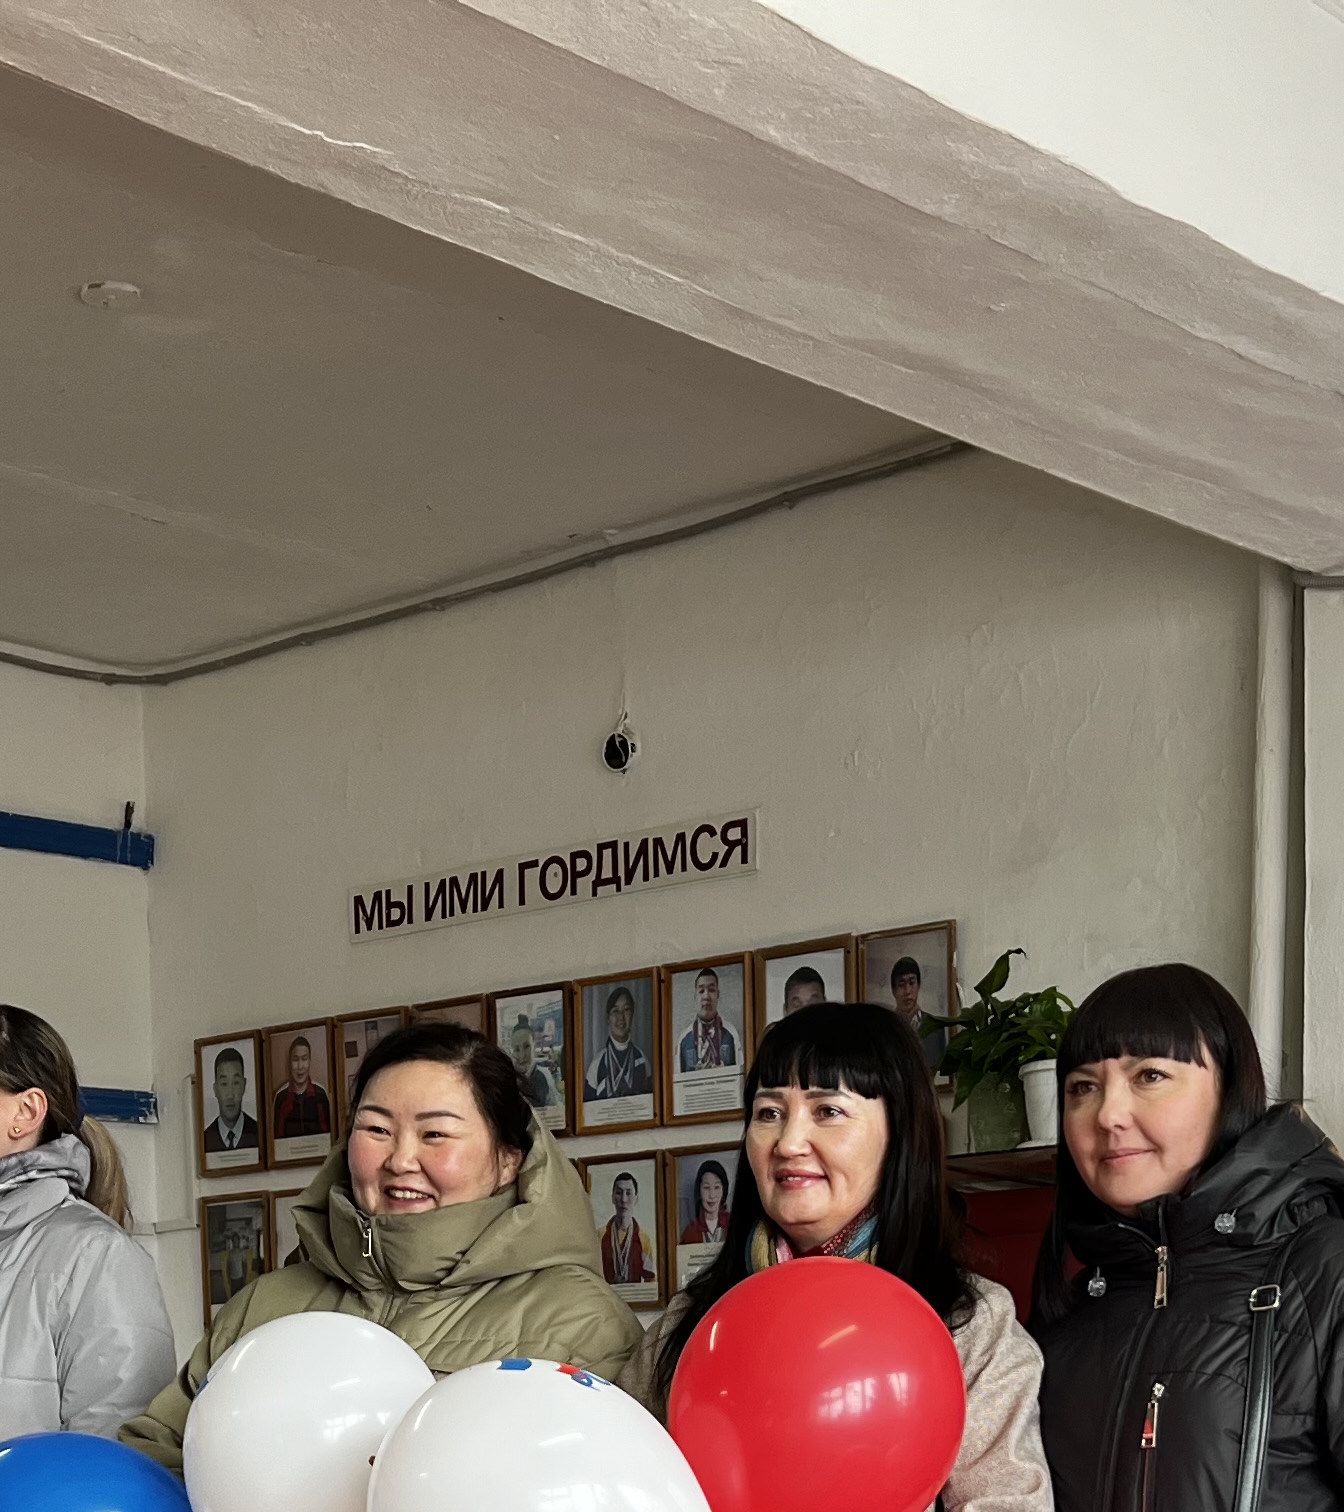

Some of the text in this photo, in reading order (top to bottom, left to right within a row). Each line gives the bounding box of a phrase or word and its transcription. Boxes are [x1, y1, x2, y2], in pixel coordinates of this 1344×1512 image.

[353, 817, 749, 935] МЫ ИМИ ГОРДИМСЯ
